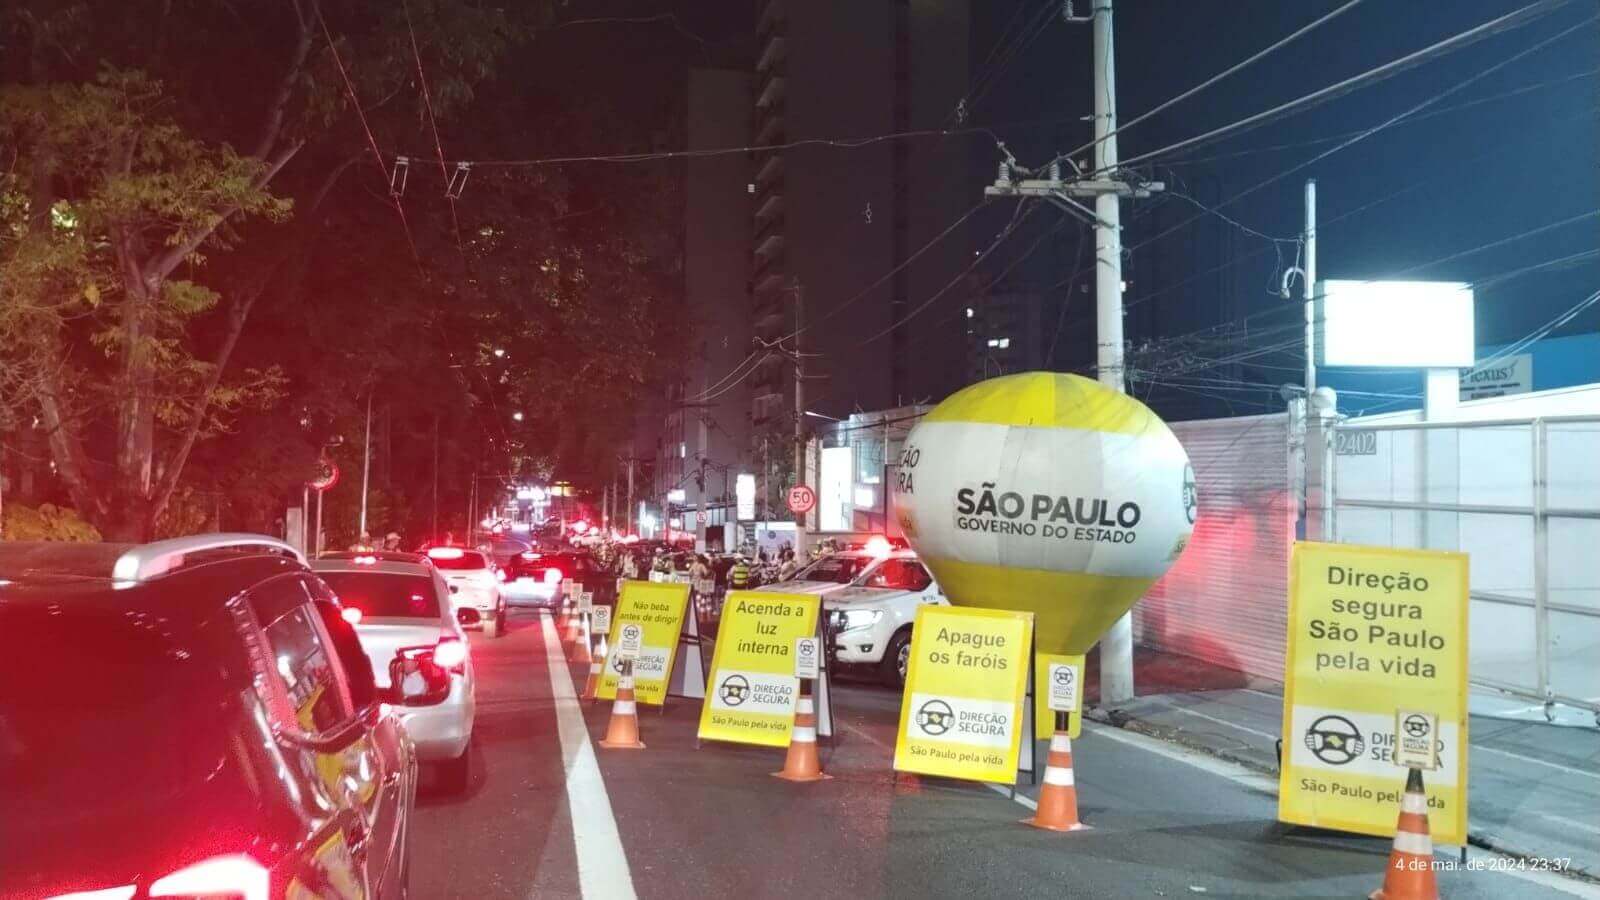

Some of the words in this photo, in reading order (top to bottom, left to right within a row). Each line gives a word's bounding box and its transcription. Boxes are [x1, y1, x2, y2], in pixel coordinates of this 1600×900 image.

[1337, 434, 1375, 455] 2402
[792, 492, 809, 504] 50
[957, 482, 1025, 519] SÃO
[1032, 495, 1140, 529] PAULO
[958, 517, 1036, 537] GOVERNO
[1043, 523, 1068, 539] DO
[1074, 529, 1137, 544] ESTADO
[1327, 566, 1429, 594] Direção
[633, 601, 649, 610] Não
[651, 602, 670, 612] beba
[736, 600, 792, 618] Acenda
[795, 605, 804, 618] a
[1331, 599, 1423, 621] segura
[620, 613, 641, 621] antes
[643, 613, 652, 622] de
[654, 614, 679, 625] dirigir
[756, 621, 777, 637] luz
[1309, 619, 1359, 643] São
[1368, 625, 1446, 650] Paulo
[737, 639, 789, 656] interna
[936, 628, 1006, 649] Apague
[929, 652, 950, 665] os
[956, 652, 1008, 670] faróis
[1315, 651, 1370, 672] pela
[1380, 656, 1437, 678] vida
[752, 692, 790, 705] SEGURA
[754, 683, 793, 696] DIREÇÃO
[712, 716, 726, 726] São
[727, 717, 749, 728] Paulo
[750, 718, 768, 730] pela
[769, 720, 787, 731] vida
[960, 711, 1007, 725] DIREÇÃO
[958, 723, 1006, 737] SEGURA
[910, 745, 927, 756] São
[930, 747, 956, 760] Paulo
[958, 750, 980, 764] pela
[982, 753, 1003, 766] vida
[1301, 779, 1327, 793] São
[1331, 783, 1373, 800] Paulo
[1377, 788, 1402, 804] pel
